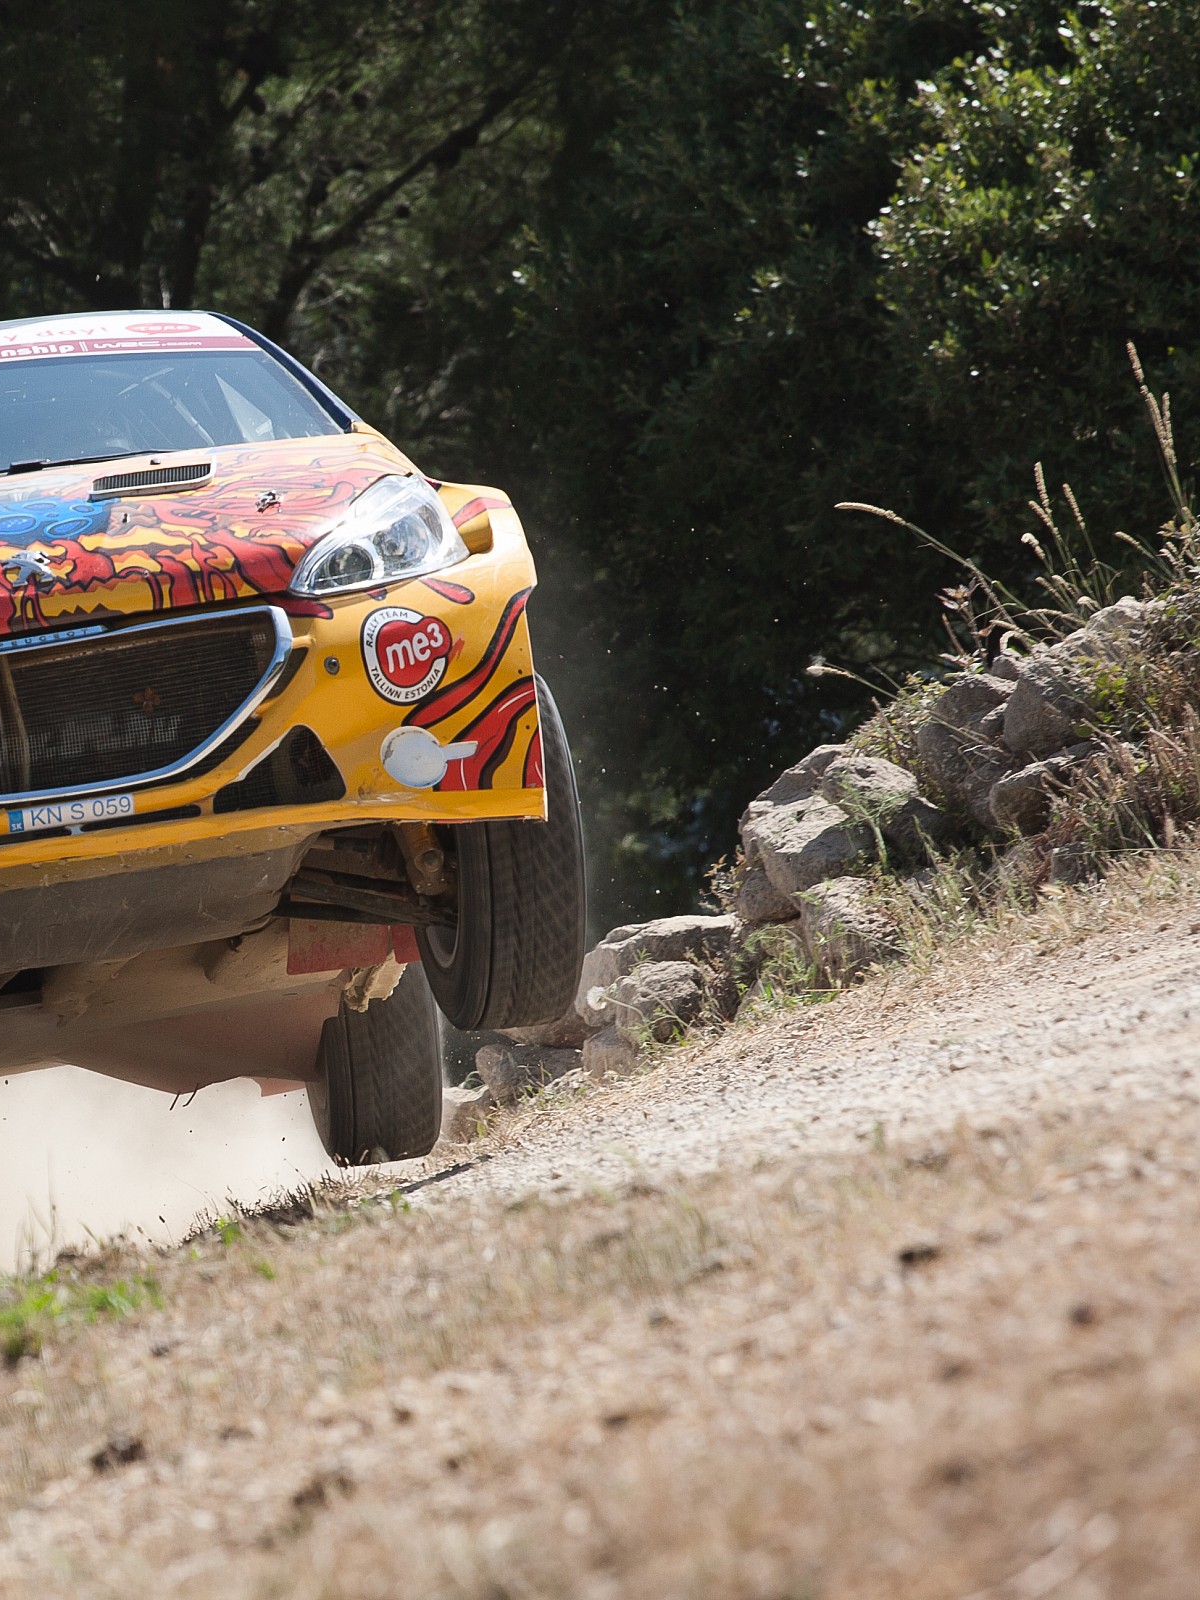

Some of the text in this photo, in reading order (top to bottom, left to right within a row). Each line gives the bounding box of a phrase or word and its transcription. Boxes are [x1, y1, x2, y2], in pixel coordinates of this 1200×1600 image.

[366, 610, 408, 648] RALLY TEAM
[385, 622, 444, 674] me3
[370, 665, 441, 700] TALLINN ESTONIA
[11, 822, 23, 831] SK
[30, 796, 131, 826] KN S 059
